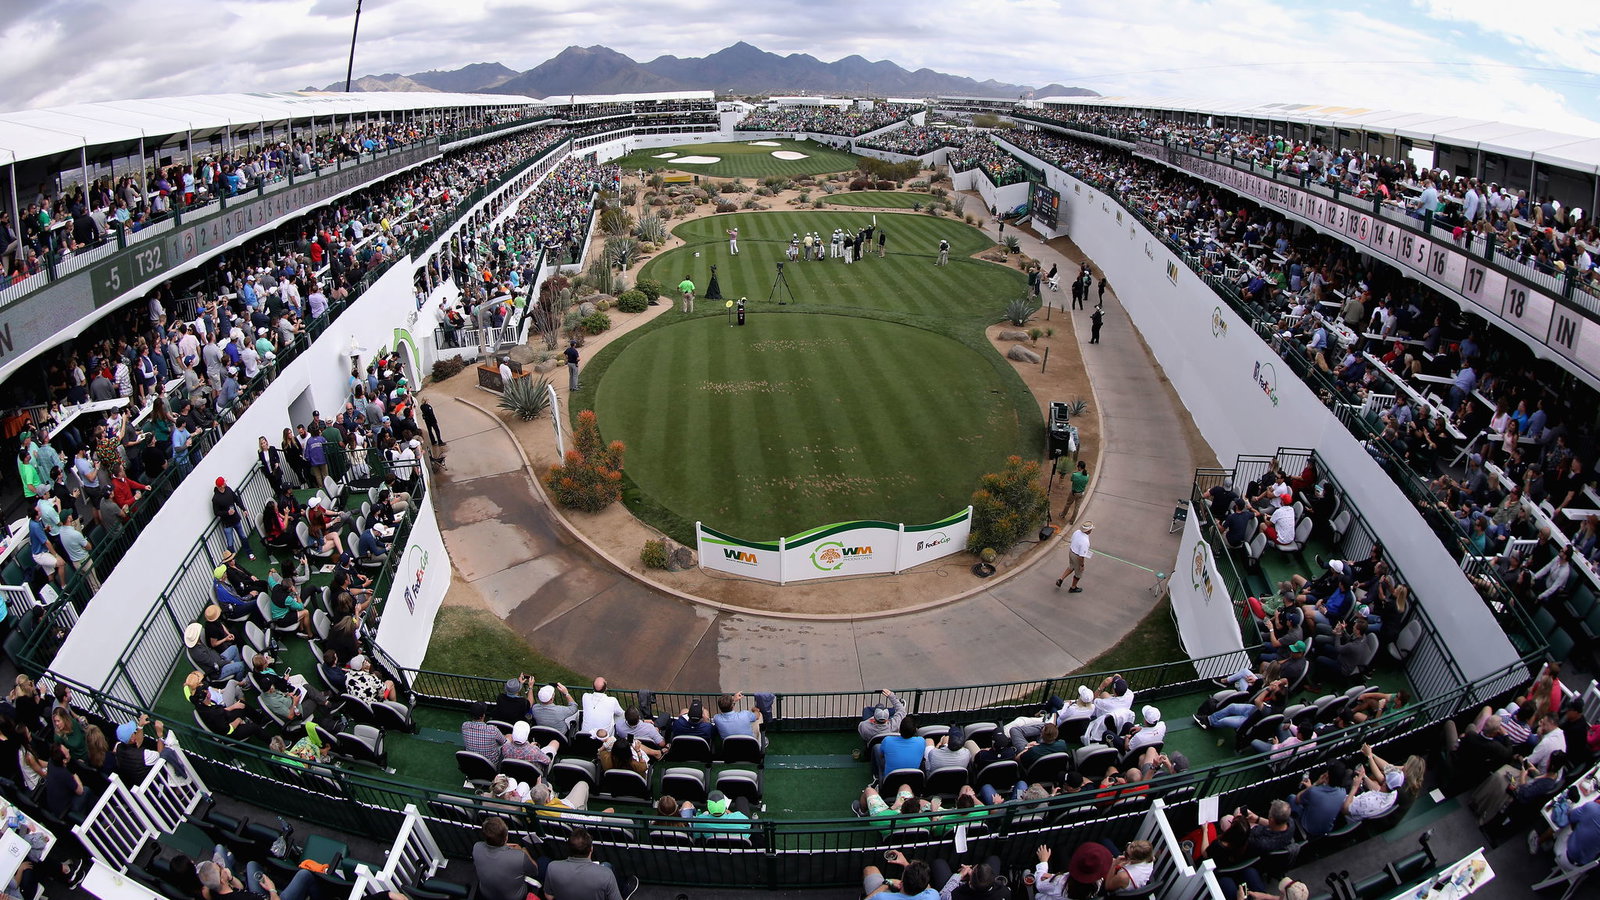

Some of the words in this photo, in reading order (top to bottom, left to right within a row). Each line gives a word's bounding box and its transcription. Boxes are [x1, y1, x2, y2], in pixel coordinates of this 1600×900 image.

[105, 266, 121, 291] -5
[135, 246, 163, 277] T32
[173, 240, 179, 259] 1
[187, 235, 193, 254] 3
[200, 228, 206, 246] 2
[212, 224, 218, 240] 4
[226, 218, 231, 236] 3
[247, 208, 253, 225] 4
[258, 206, 263, 221] 3
[267, 202, 273, 217] 5
[1166, 258, 1178, 283] WM
[1269, 186, 1279, 201] OUT
[1279, 188, 1288, 205] 35
[1290, 192, 1297, 208] 10
[1299, 196, 1304, 211] 4
[1307, 198, 1315, 216] 11
[1317, 203, 1323, 219] 4
[1328, 206, 1337, 225] 12
[1339, 211, 1345, 228] 3
[1349, 214, 1358, 234] 13
[1374, 224, 1384, 246] 14
[1388, 230, 1394, 250] 4
[1402, 235, 1413, 259] 15
[1417, 244, 1425, 263] 5
[1433, 250, 1445, 275] 16
[1468, 267, 1484, 294] 17
[1510, 288, 1526, 318] 18
[1555, 315, 1577, 350] IN
[723, 548, 758, 564] WM
[841, 545, 873, 556] WM
